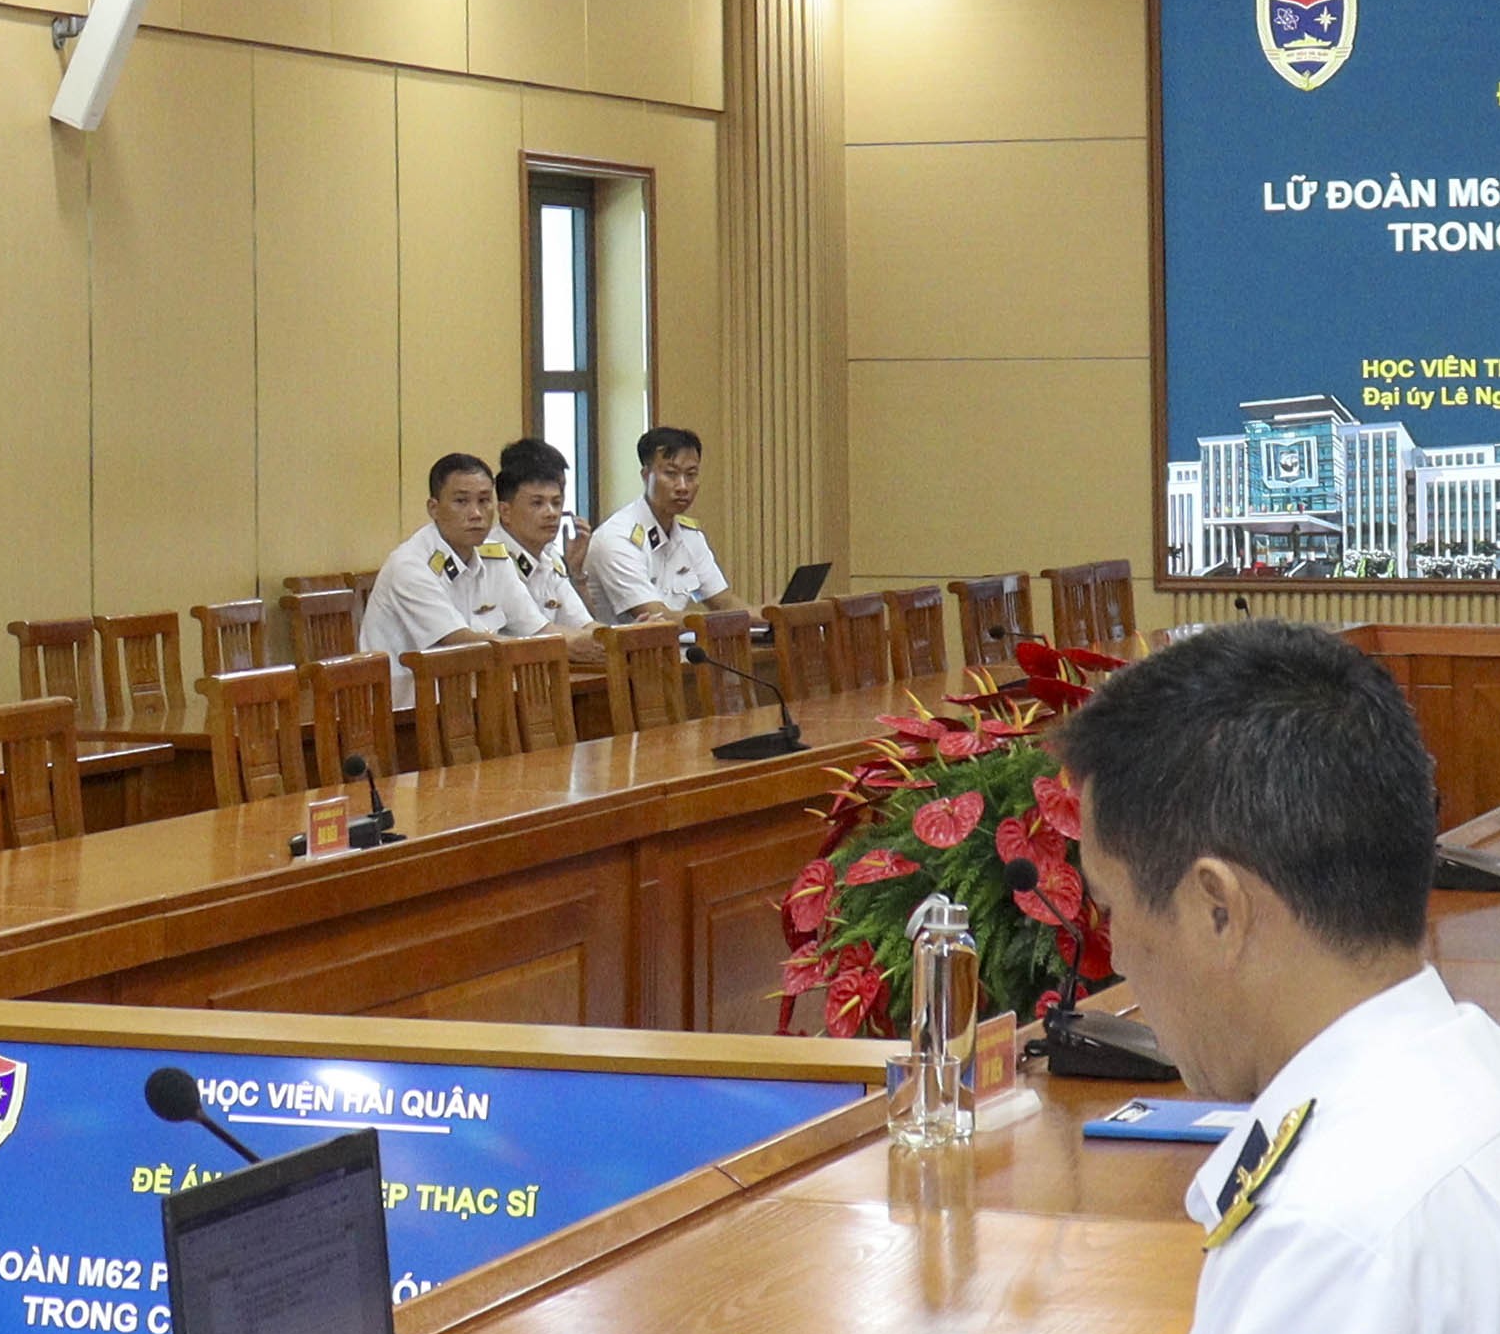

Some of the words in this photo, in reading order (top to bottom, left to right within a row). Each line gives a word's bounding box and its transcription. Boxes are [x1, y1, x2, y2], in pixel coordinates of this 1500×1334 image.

[1264, 175, 1317, 210] LỮ
[1326, 173, 1436, 209] ĐOÀN
[1363, 360, 1414, 383] HỌC
[1421, 355, 1476, 378] VIÊN
[1363, 387, 1399, 410] Đại
[1407, 387, 1434, 409] úy
[1441, 387, 1468, 405] Lê
[196, 1078, 259, 1113] HỌC
[267, 1080, 336, 1117] VIỆN
[401, 1085, 491, 1122] QUÂN
[131, 1164, 174, 1195] ĐỀ
[415, 1183, 500, 1221] THẠC
[505, 1184, 540, 1219] SĨ
[77, 1256, 142, 1290] M62
[22, 1295, 138, 1334] TRONG
